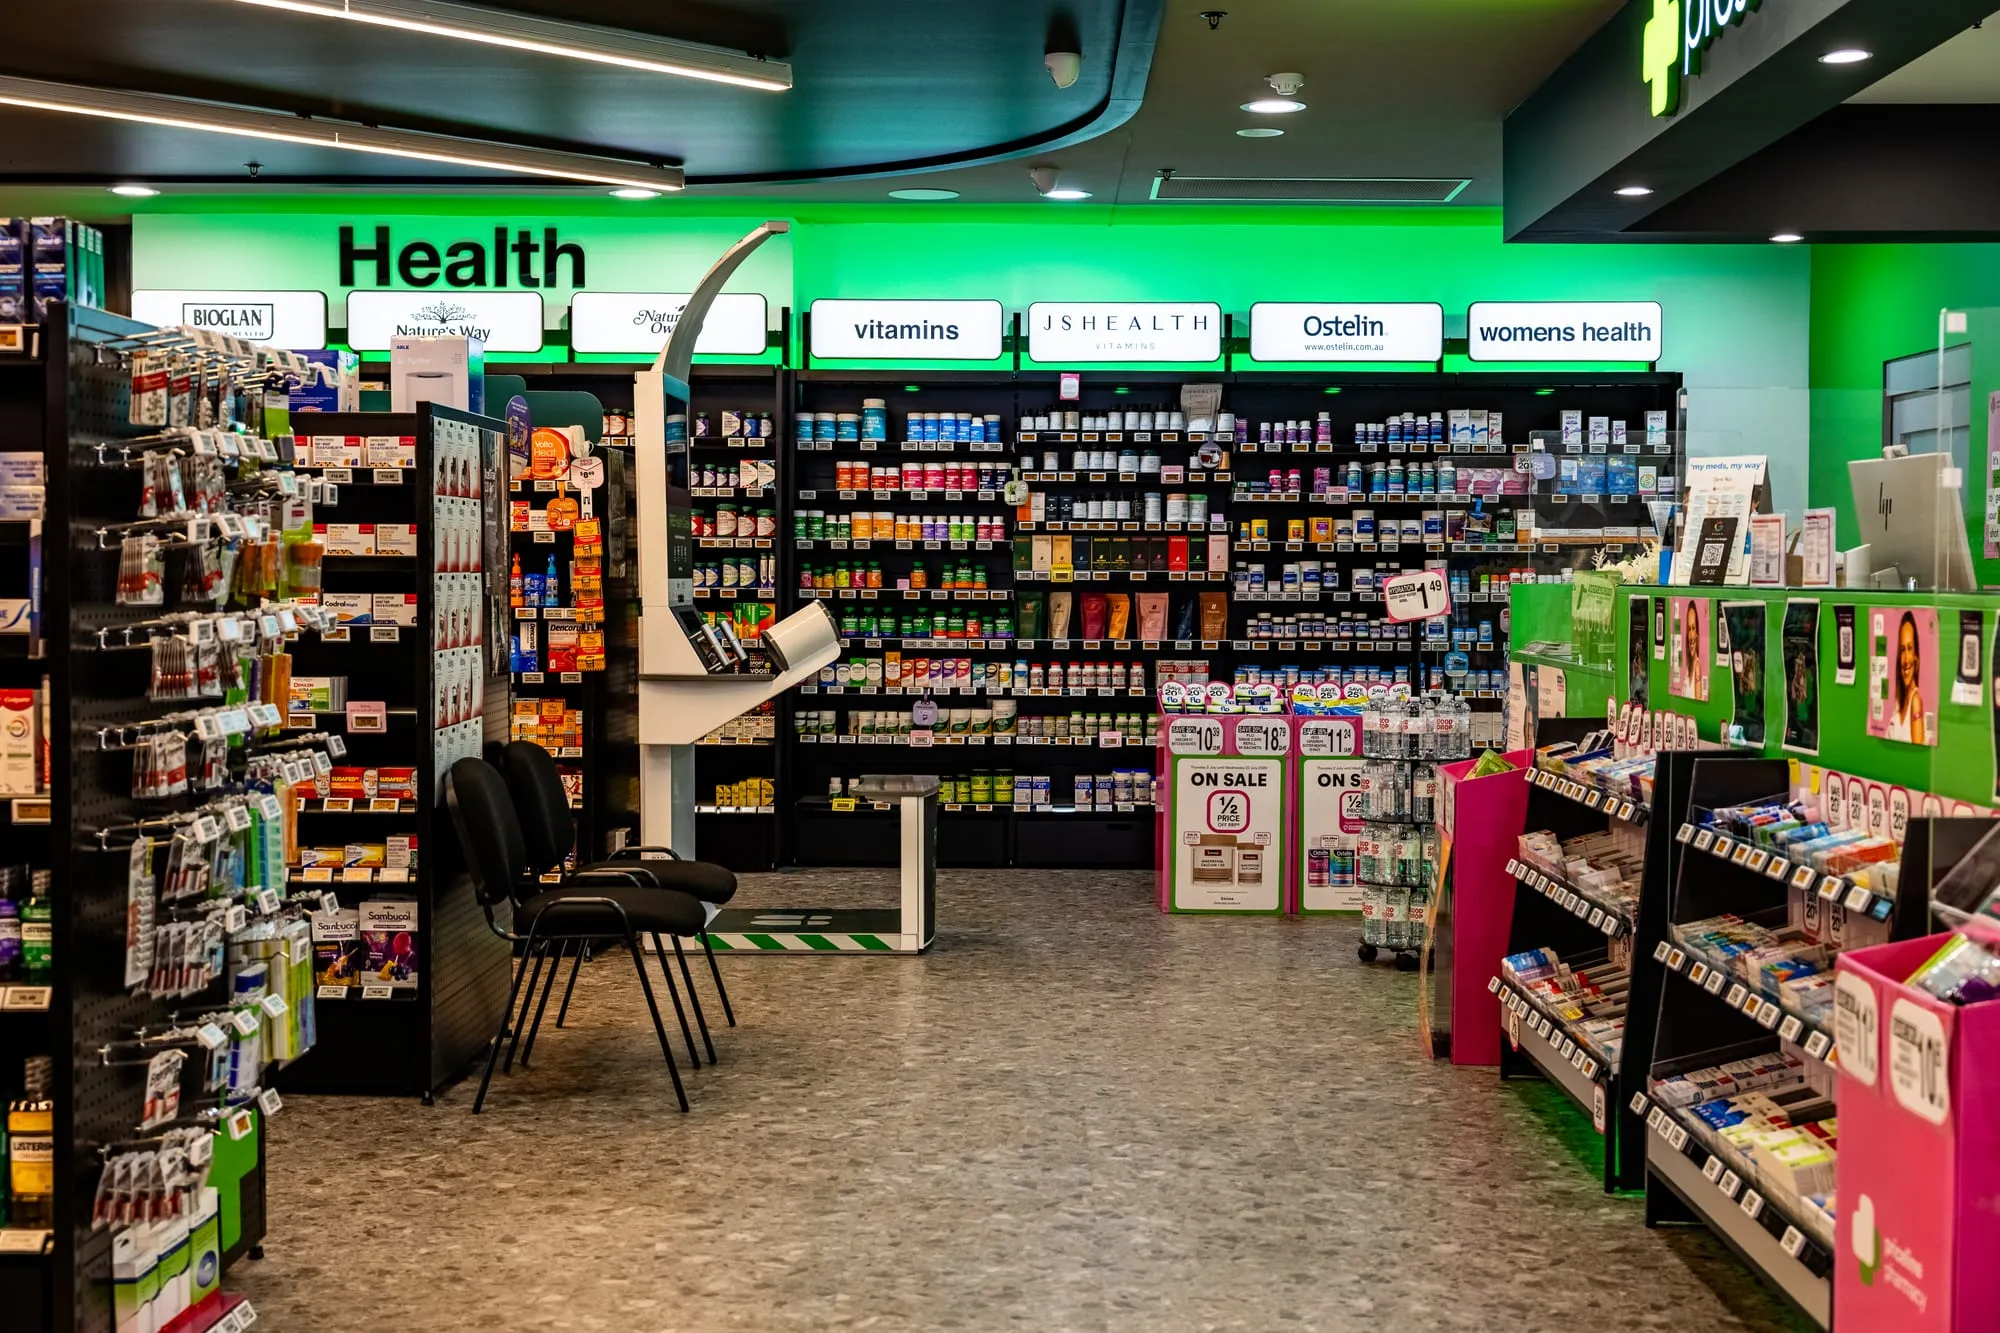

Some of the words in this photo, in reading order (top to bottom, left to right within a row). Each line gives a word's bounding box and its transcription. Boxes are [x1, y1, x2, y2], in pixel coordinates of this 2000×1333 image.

[338, 227, 586, 288] Health
[193, 309, 262, 326] BIOGLAN
[1043, 314, 1207, 331] JSHEALTH
[855, 320, 959, 340] vitamins
[1303, 314, 1384, 337] Ostelin
[1480, 323, 1576, 342] womens
[1582, 321, 1651, 342] health
[396, 324, 456, 336] Nature's
[459, 324, 491, 343] Way
[1095, 342, 1156, 350] VITAMINS
[1304, 343, 1384, 352] www.ostelin.com.au
[533, 448, 556, 456] Heat
[1730, 463, 1743, 471] my
[1197, 727, 1212, 751] 10
[1212, 727, 1220, 737] 39
[1263, 727, 1279, 751] 18
[1279, 727, 1287, 737] 79
[1343, 729, 1351, 739] 24
[1328, 729, 1342, 752] 11
[1191, 772, 1218, 786] ON
[1223, 773, 1267, 787] SALE
[1317, 773, 1344, 787] ON
[1217, 814, 1240, 822] PRICE
[368, 911, 411, 921] Sambucol
[318, 921, 358, 930] Sambucol
